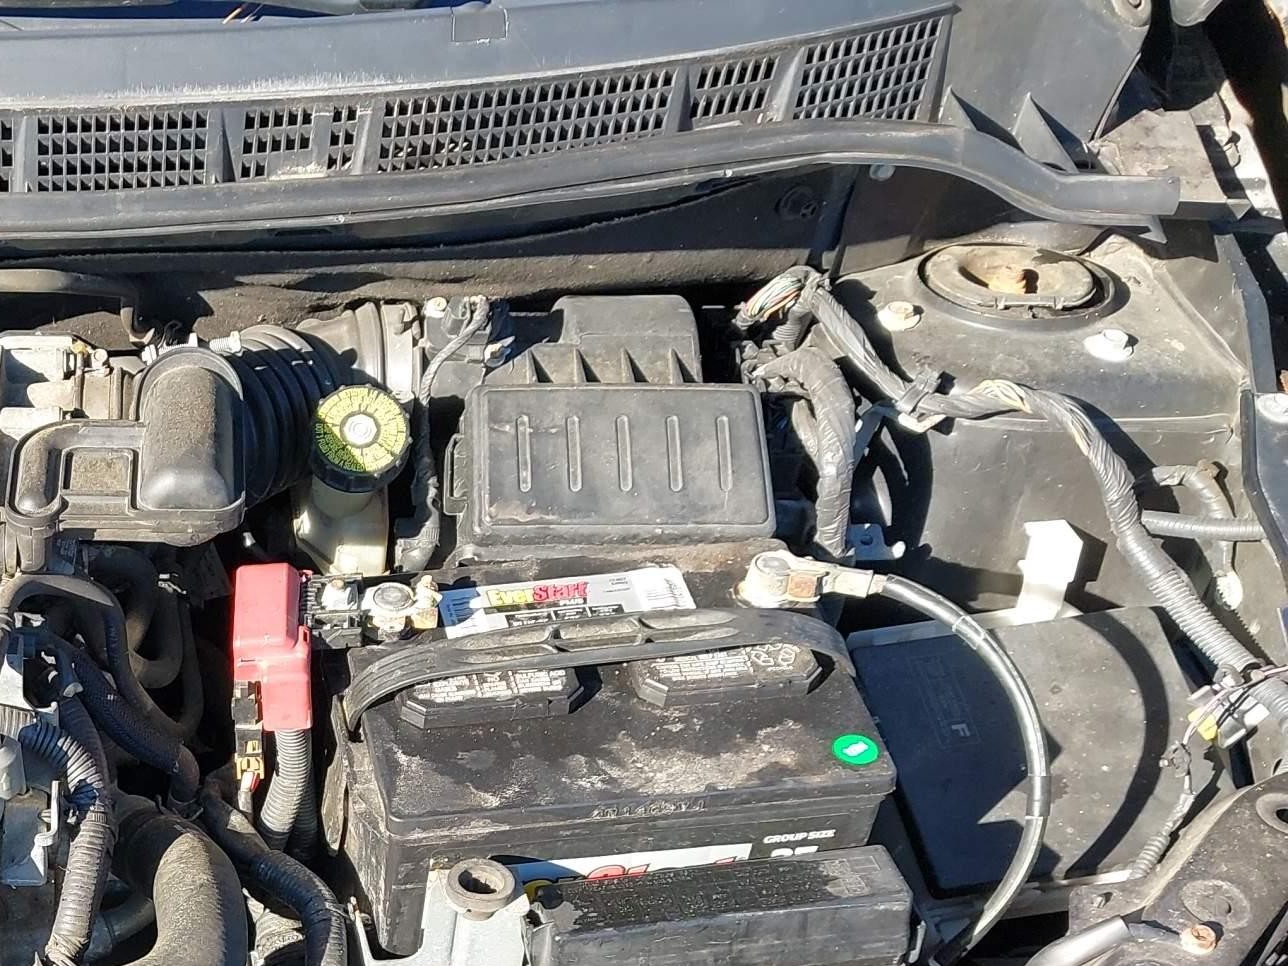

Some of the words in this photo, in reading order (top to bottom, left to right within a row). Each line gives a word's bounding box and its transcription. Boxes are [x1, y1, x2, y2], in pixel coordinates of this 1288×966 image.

[486, 582, 590, 606] EverStart
[763, 832, 808, 844] GROUP
[807, 829, 836, 839] SIZE
